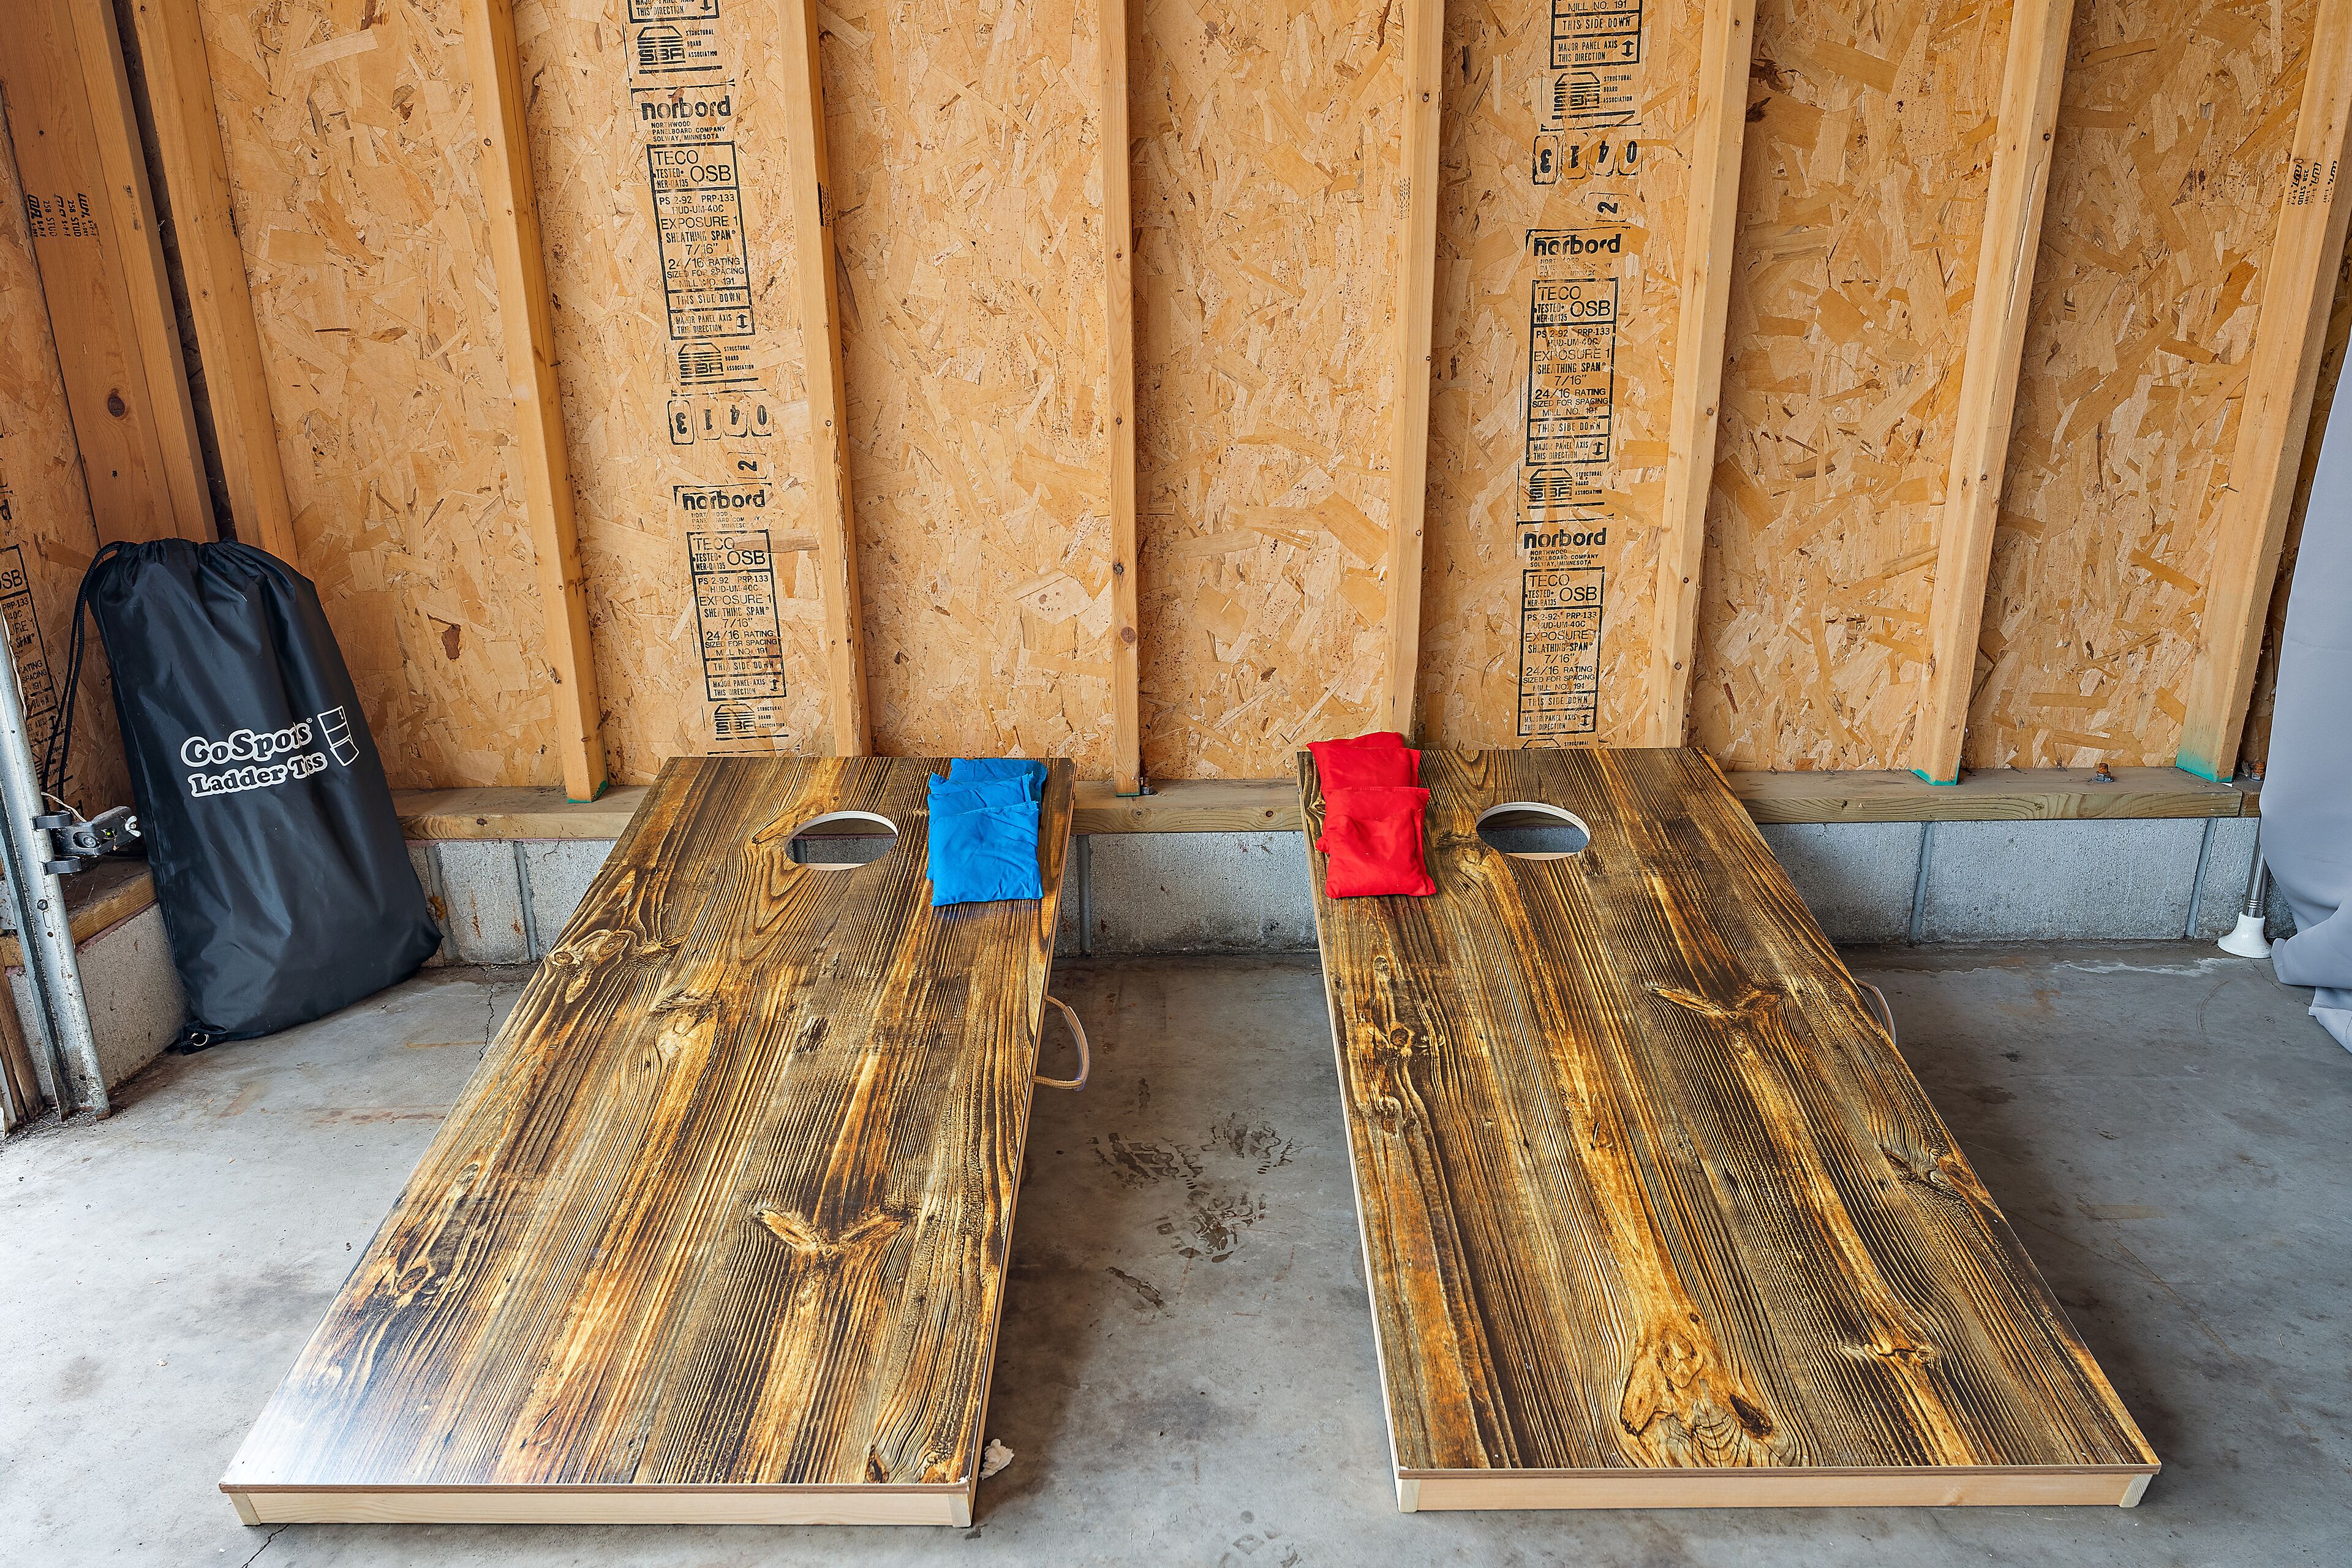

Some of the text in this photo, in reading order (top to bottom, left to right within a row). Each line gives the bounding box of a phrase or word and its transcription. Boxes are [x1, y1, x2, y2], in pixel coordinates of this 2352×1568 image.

[636, 6, 684, 16] THIS DIRECTION
[1569, 2, 1588, 12] MILL
[1562, 17, 1630, 31] THIS SIDE DOWN
[1559, 42, 1578, 51] MAJOR
[1582, 41, 1600, 50] PANEL
[1575, 52, 1605, 61] DIRECTION
[641, 96, 731, 120] norbord
[654, 150, 698, 165] TECO
[690, 165, 731, 183] OSB
[46, 217, 57, 236] STUD
[71, 217, 81, 238] STUD
[661, 216, 737, 230] EXPOSURE 1
[1534, 233, 1621, 256] norbord
[709, 258, 740, 266] RATING
[677, 293, 741, 304] THIS SIDE DOWN
[1538, 286, 1581, 301] TECO
[1570, 300, 1610, 317] OSB
[698, 315, 715, 323] PANEL
[1606, 349, 1610, 358] 1
[1535, 389, 1569, 399] 24/16
[1538, 422, 1575, 432] THIS SIDE
[682, 490, 765, 510] norbord
[693, 537, 734, 550] TECO
[1524, 527, 1607, 549] norbord
[727, 551, 766, 565] OSB
[1529, 574, 1569, 587] TECO
[699, 594, 771, 606] EXPOSURE 1
[1559, 587, 1597, 601] OSB
[706, 630, 739, 640] 24/16
[1525, 630, 1588, 641] EXPOSURE
[1526, 666, 1558, 676] 24/16
[32, 682, 42, 690] 191
[187, 764, 288, 797] Ladder
